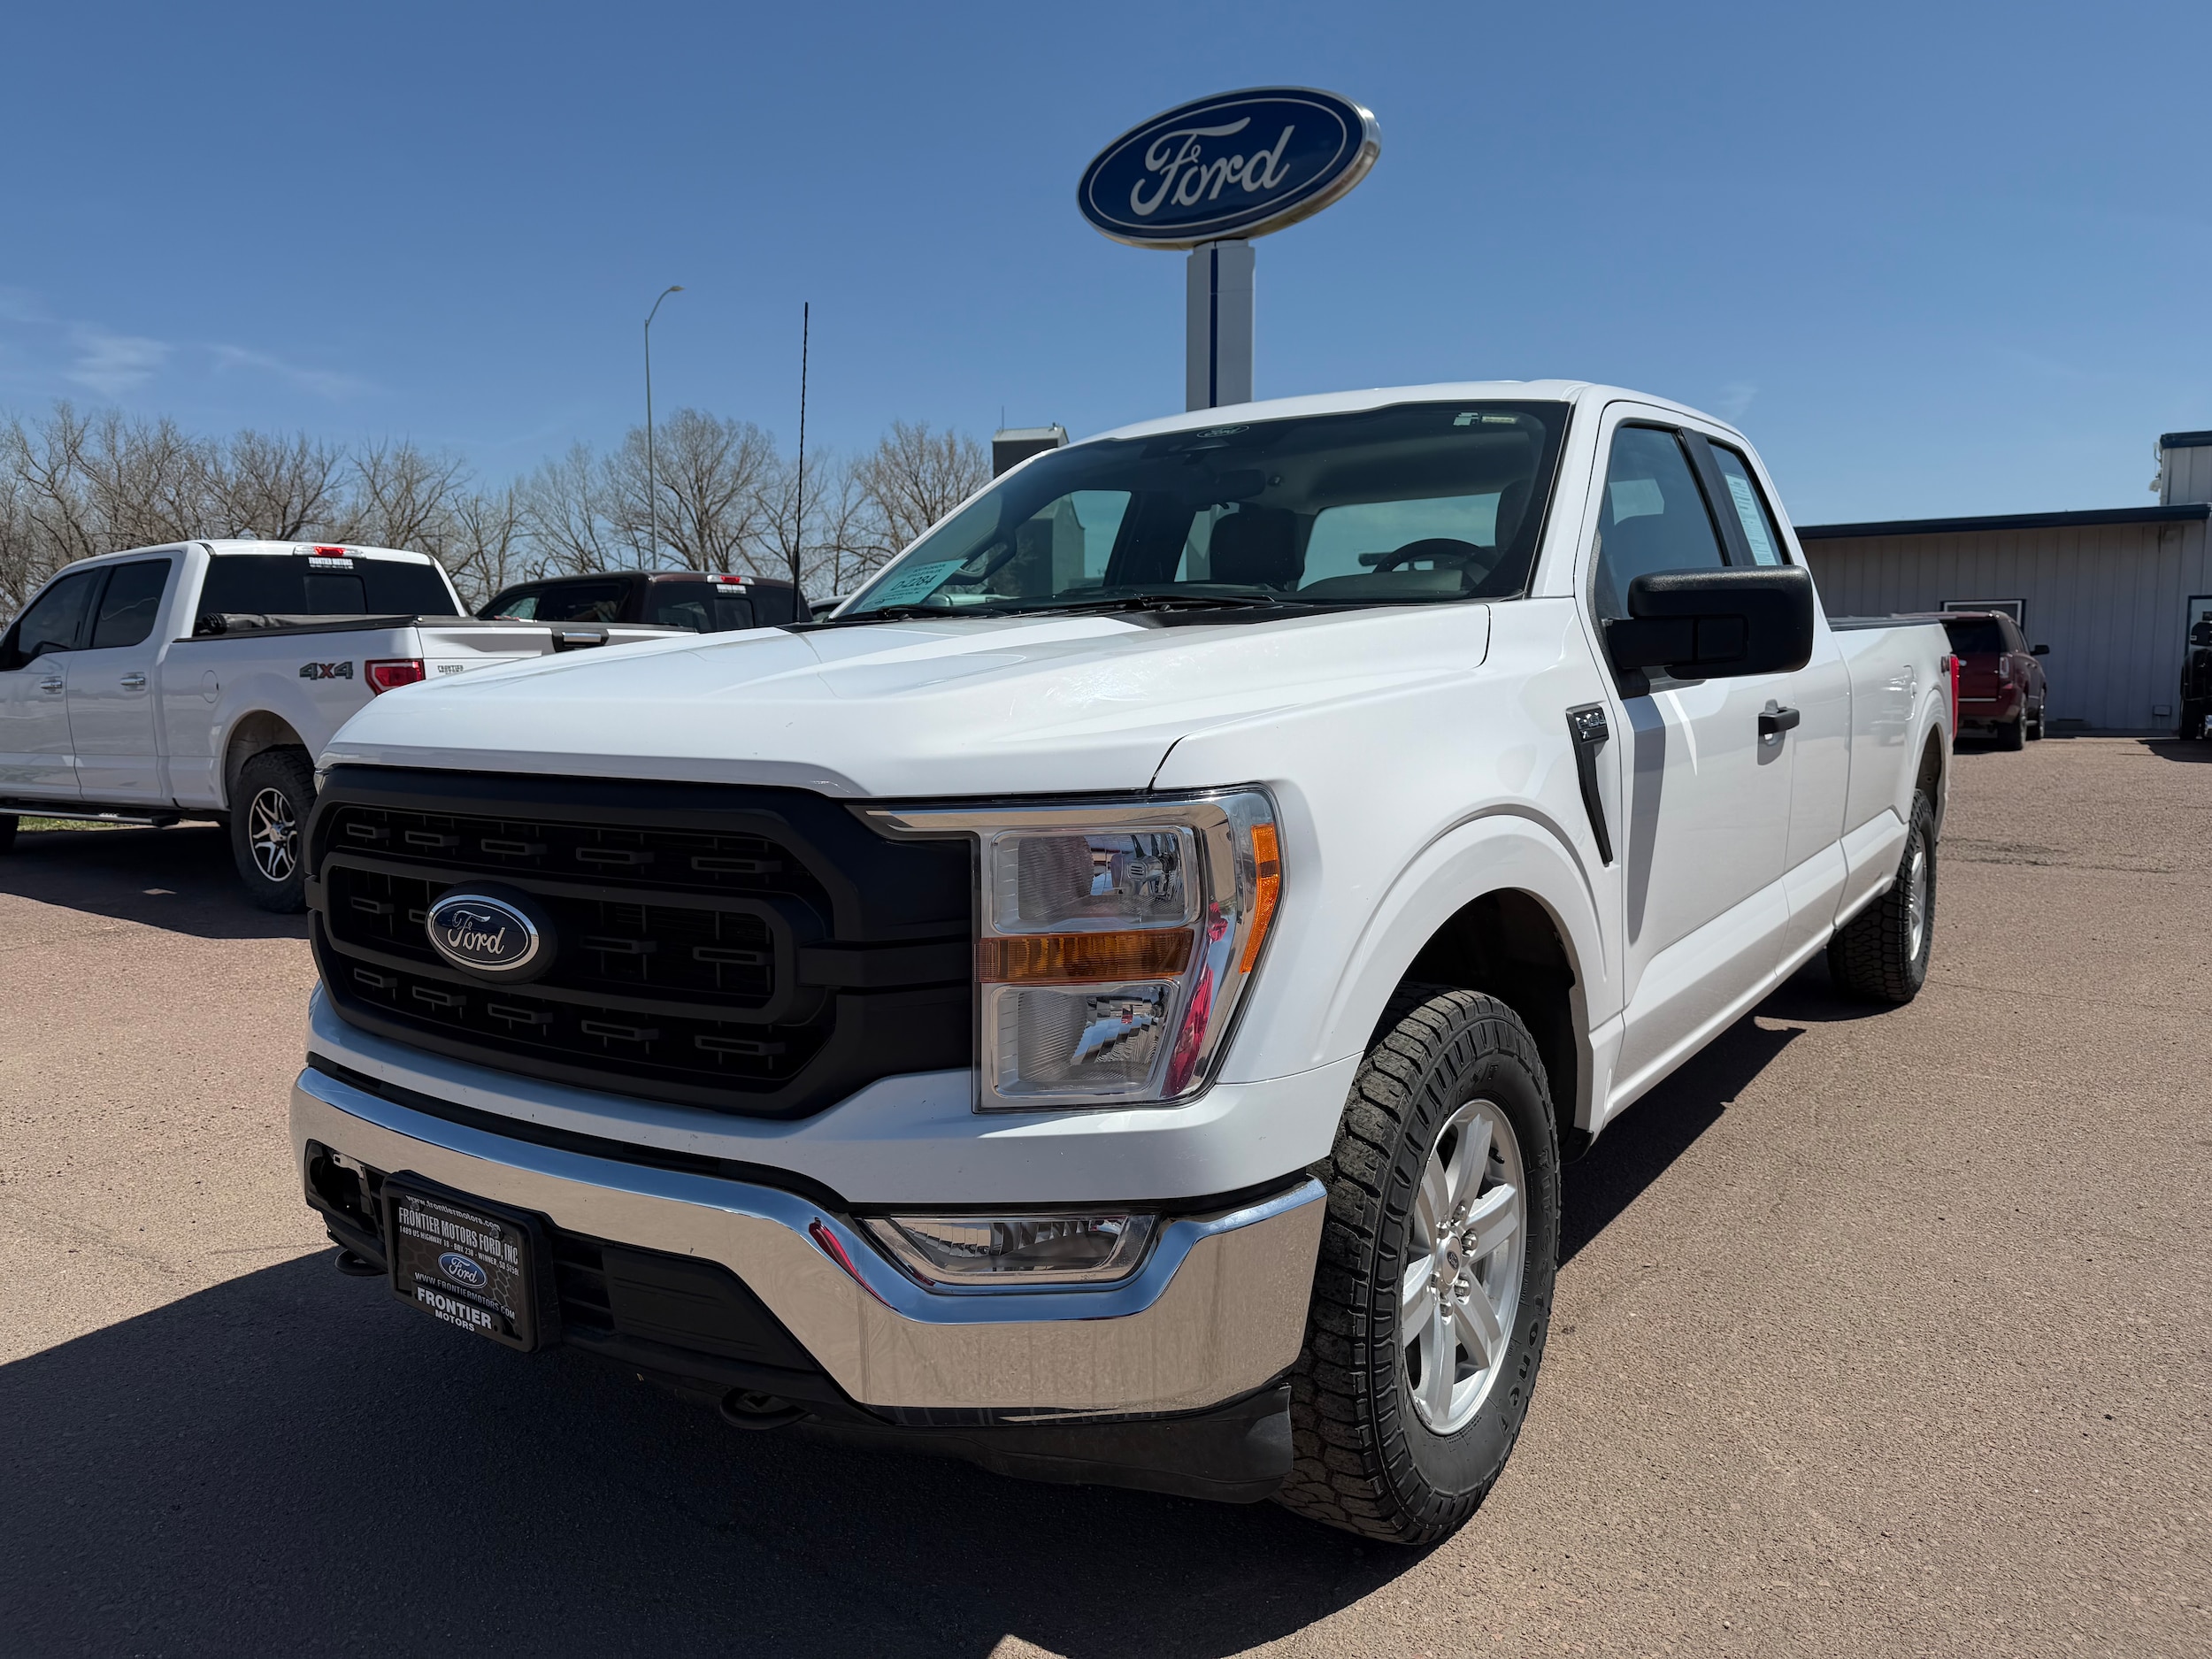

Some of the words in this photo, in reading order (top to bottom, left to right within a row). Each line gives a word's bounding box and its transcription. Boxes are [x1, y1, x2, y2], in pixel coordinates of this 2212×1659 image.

[1130, 117, 1295, 216] Ford
[448, 910, 505, 955] Ford
[398, 1206, 441, 1235] FRONTIER
[441, 1220, 478, 1248] MOTORS
[412, 1229, 420, 1238] US
[449, 1256, 478, 1284] Ford
[417, 1286, 492, 1330] FRONTIER
[435, 1310, 475, 1333] MOTORS
